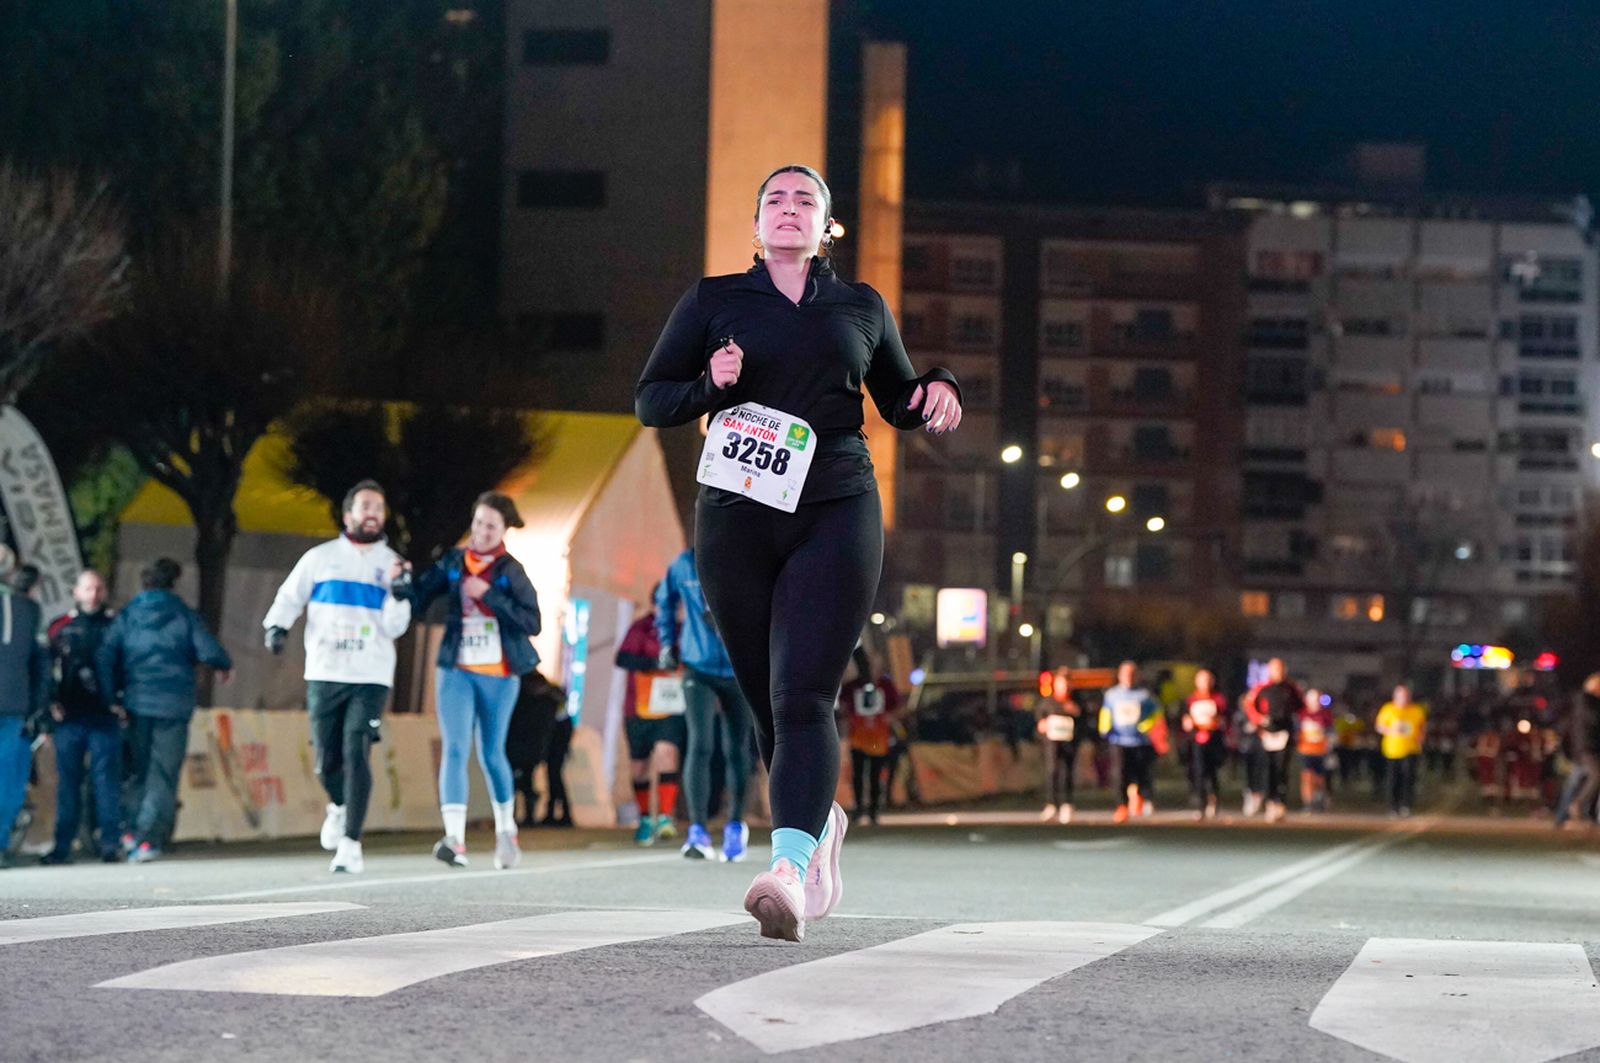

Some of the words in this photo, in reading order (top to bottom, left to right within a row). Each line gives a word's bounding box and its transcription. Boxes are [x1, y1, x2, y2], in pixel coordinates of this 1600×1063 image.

[723, 417, 743, 432] SAN
[738, 411, 769, 426] NOCHE
[769, 420, 781, 431] DE
[722, 431, 791, 476] 3258
[741, 465, 761, 478] Marina
